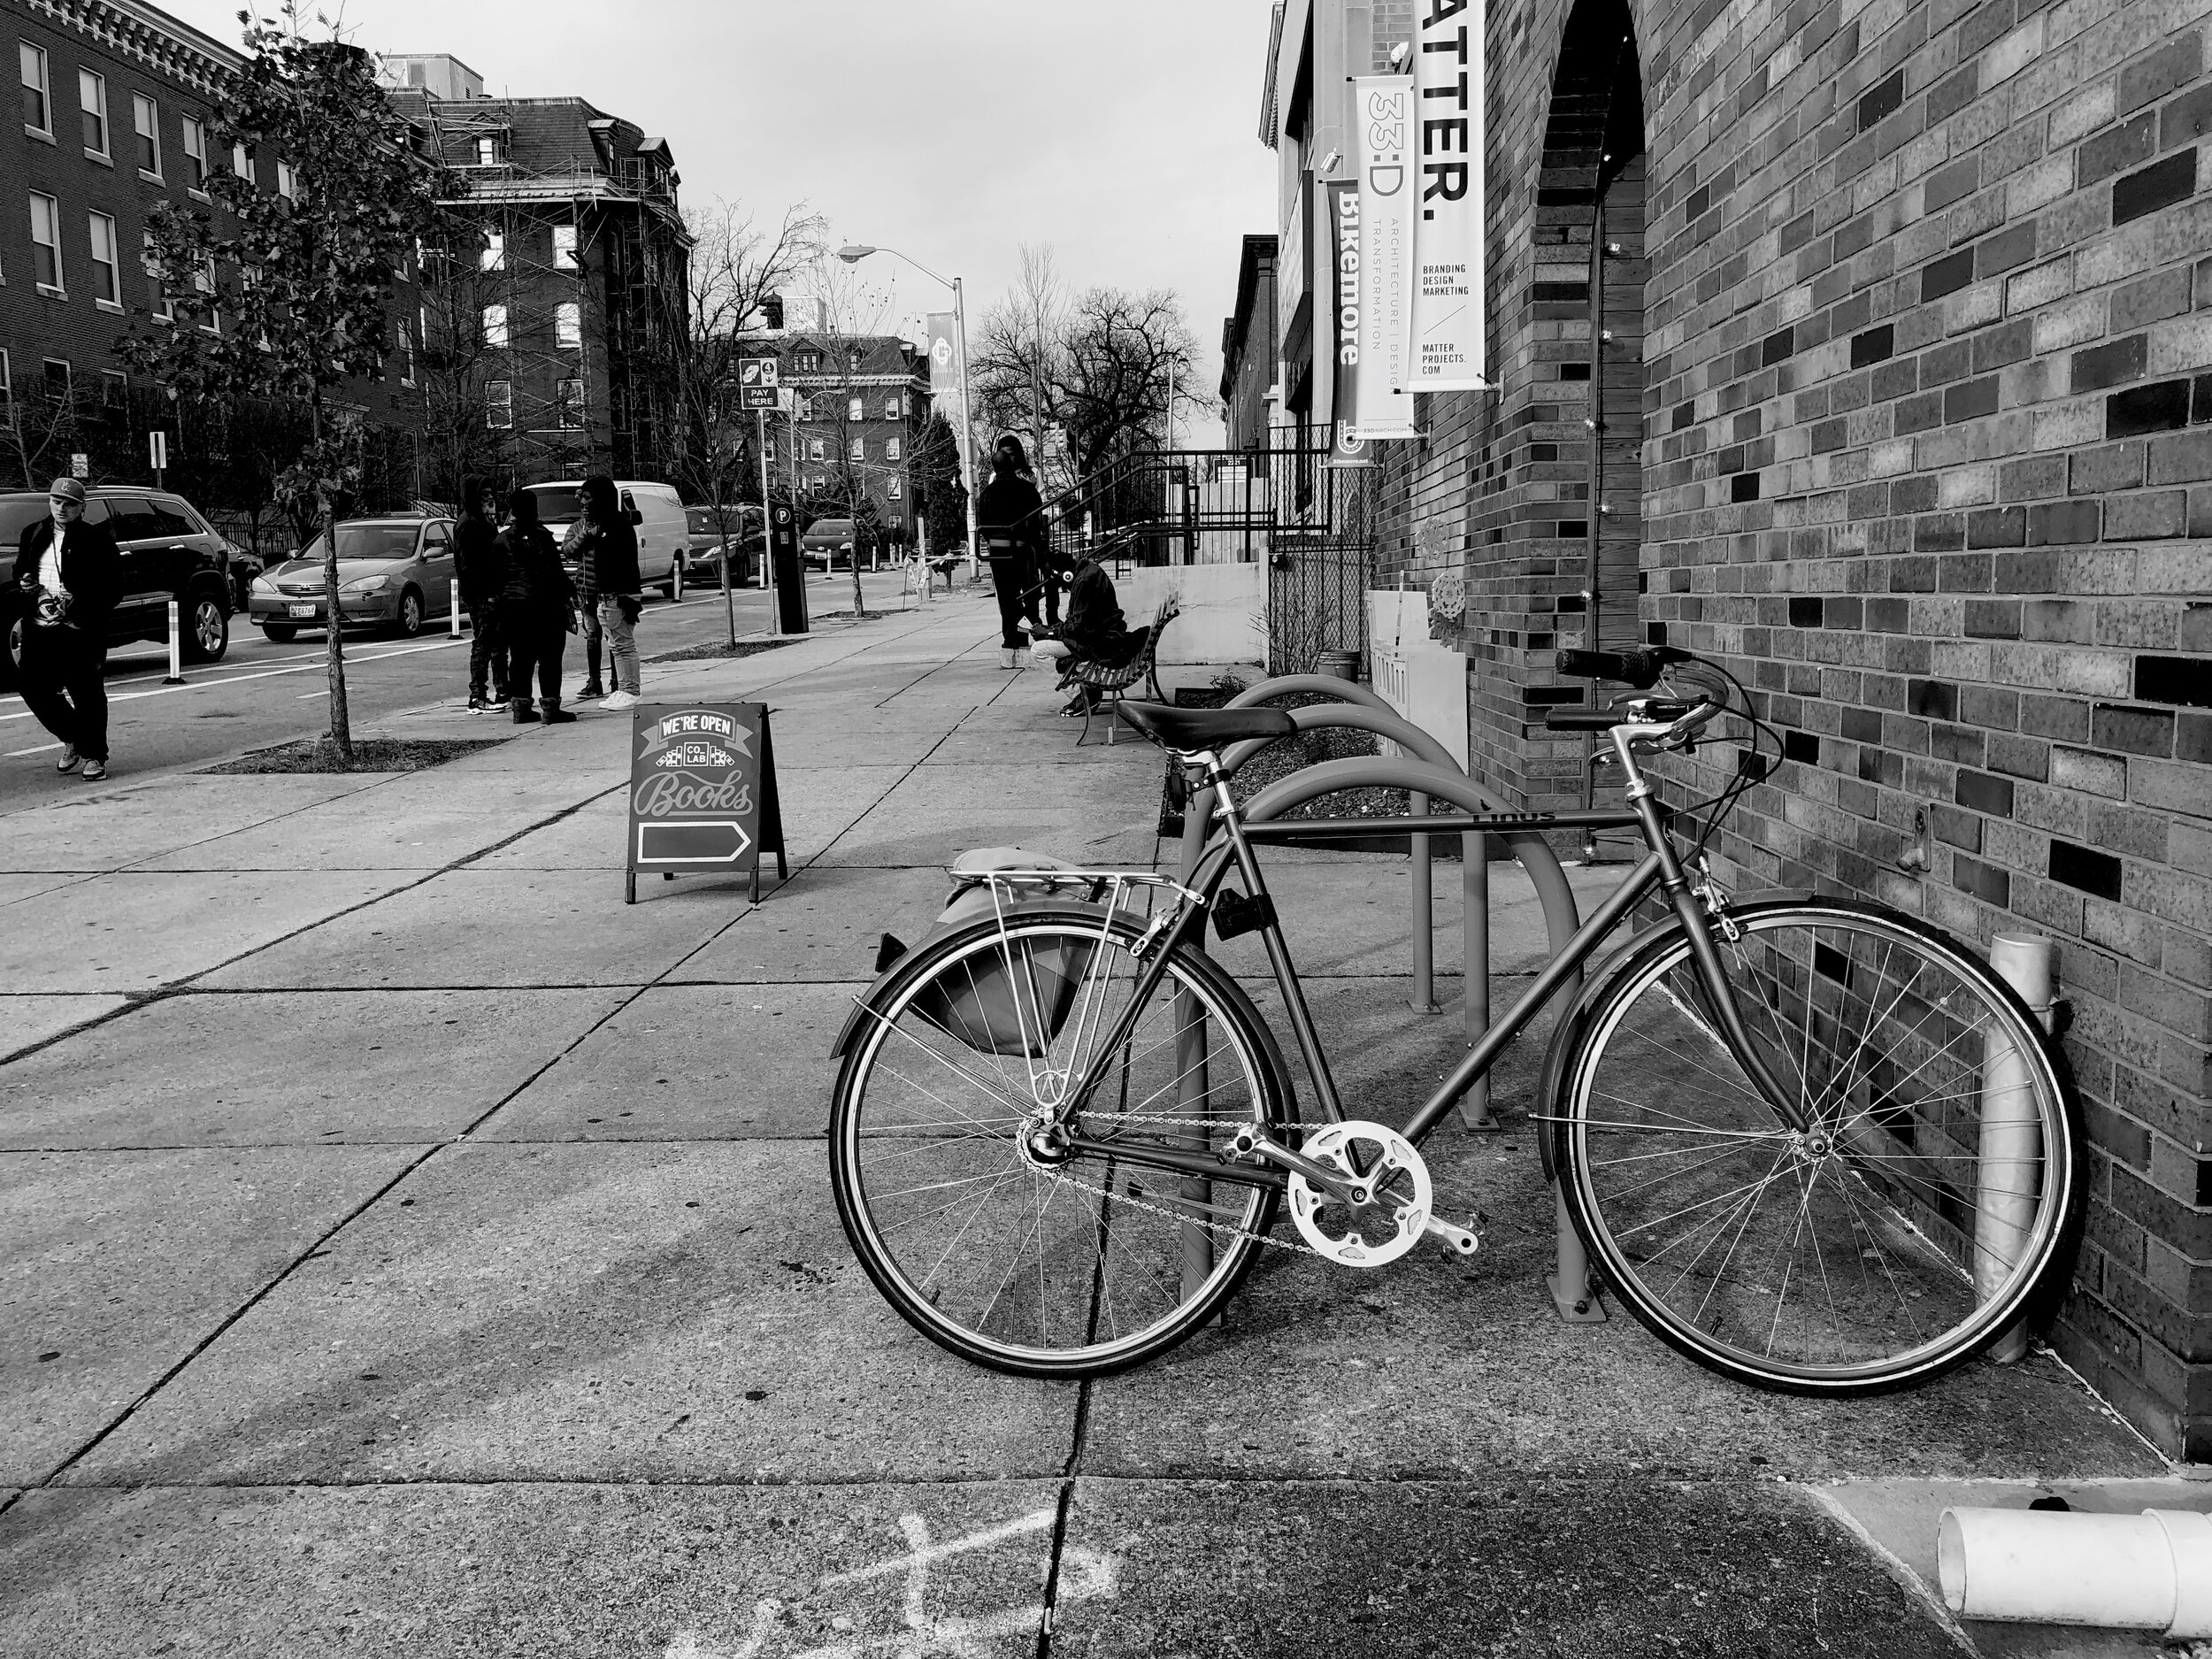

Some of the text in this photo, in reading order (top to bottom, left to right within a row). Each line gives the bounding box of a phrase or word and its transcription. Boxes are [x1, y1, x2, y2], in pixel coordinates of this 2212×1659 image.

[1390, 218, 1400, 326] ARCHITECTURE
[1422, 264, 1467, 275] BRANDING
[1340, 191, 1359, 365] Bikemore
[1422, 275, 1455, 286] DESIGN
[1372, 219, 1382, 350] TRANSFORMATION
[1422, 286, 1470, 297] MARKETING
[1422, 342, 1455, 354] MATTER
[1422, 354, 1467, 364] PROJECTS.
[1422, 365, 1440, 375] COM
[780, 510, 787, 522] P
[662, 715, 731, 736] WE'RE OPEN
[687, 755, 706, 764] LAB
[634, 769, 753, 817] Books
